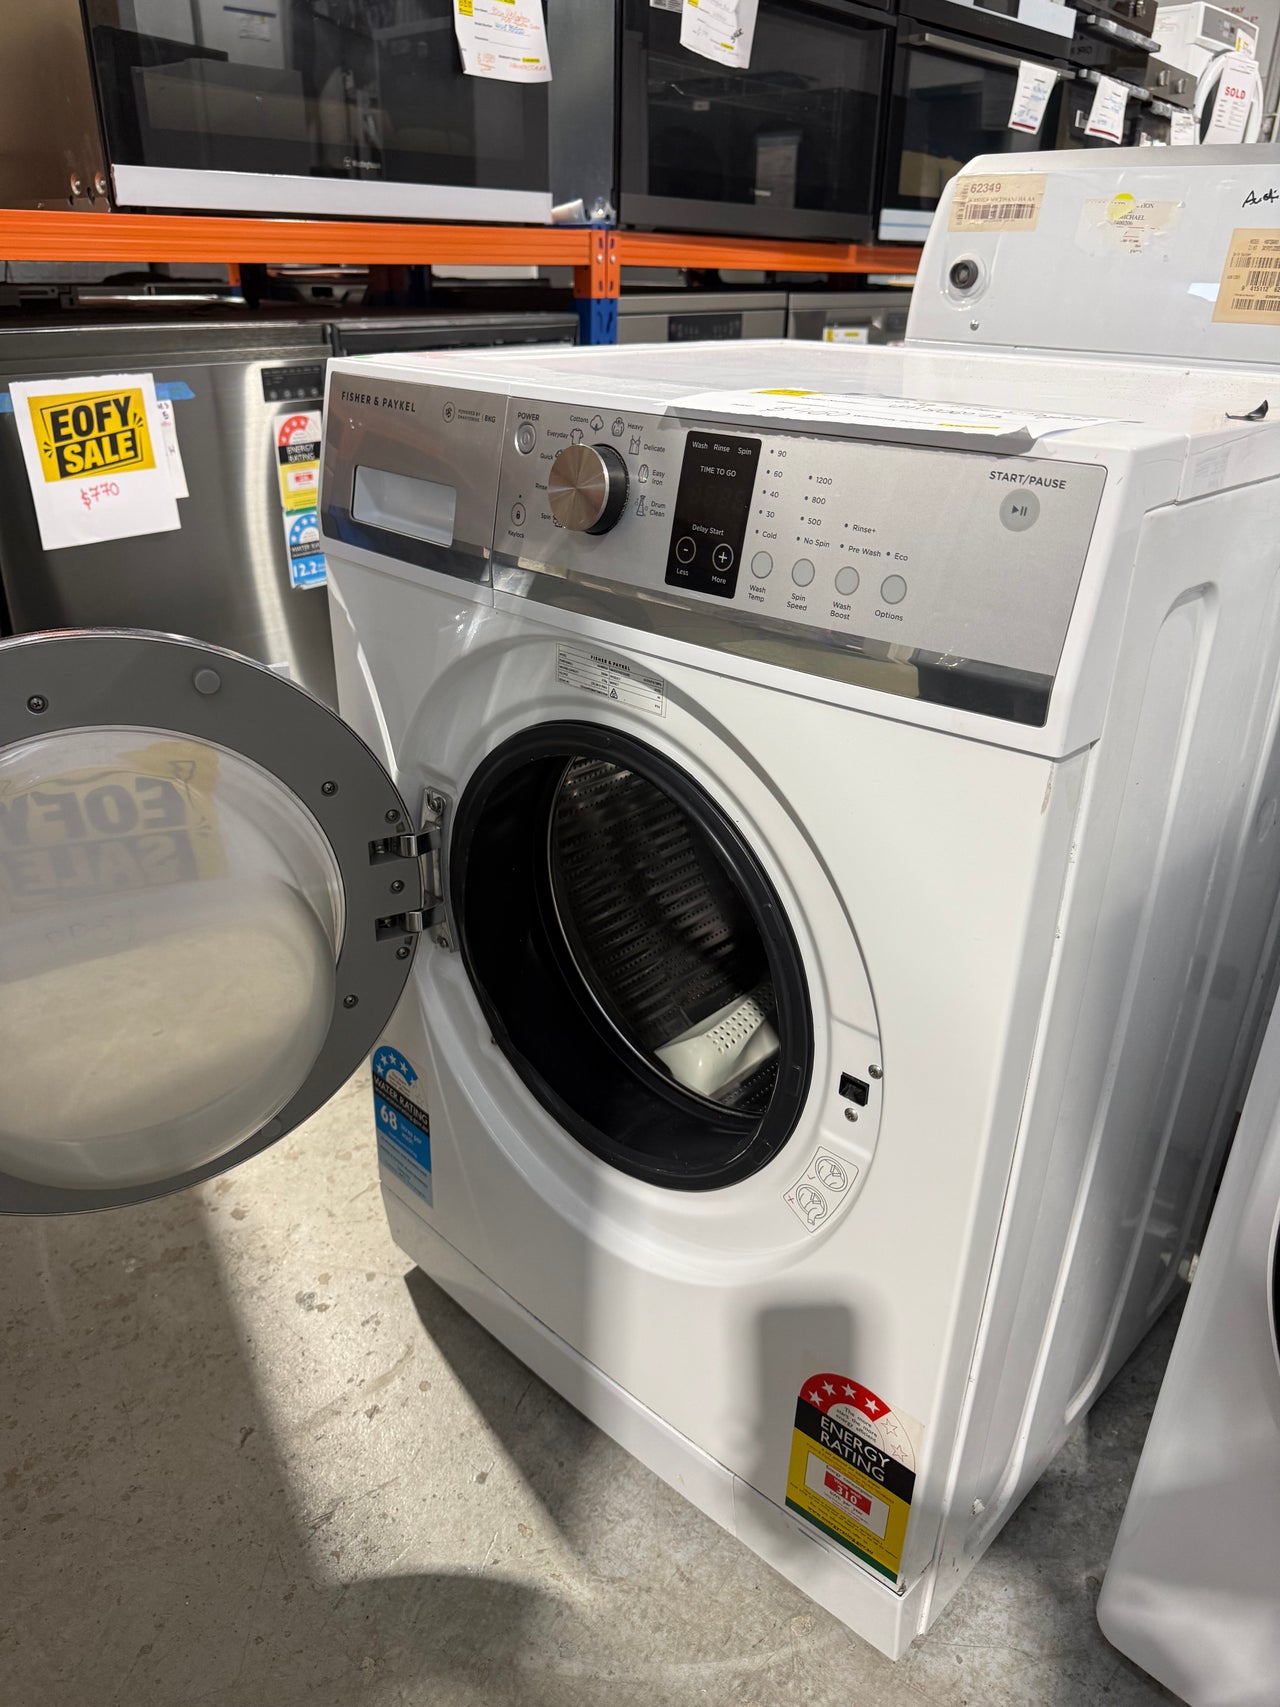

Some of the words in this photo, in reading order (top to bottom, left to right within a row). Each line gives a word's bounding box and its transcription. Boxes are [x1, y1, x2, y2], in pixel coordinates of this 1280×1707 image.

[1225, 86, 1246, 100] SOLD
[970, 183, 1001, 193] 62349
[341, 391, 371, 405] FISHER
[382, 398, 416, 413] PAYKEL
[50, 395, 131, 444] EOFY
[517, 412, 540, 421] POWER
[570, 415, 589, 424] Cottons
[627, 423, 644, 431] Heavy
[546, 430, 569, 440] Everyday
[63, 431, 135, 474] SALE
[287, 444, 315, 455] ENERGY
[643, 443, 666, 453] Delicate
[692, 441, 709, 450] Wash
[713, 443, 731, 452] Rinse
[737, 447, 752, 456] Spin
[540, 452, 554, 461] Quick
[777, 449, 787, 458] 90
[652, 469, 665, 479] Easy
[700, 465, 715, 475] TIME
[716, 468, 725, 476] TO
[726, 469, 737, 477] GO
[773, 470, 783, 478] 60
[652, 478, 663, 486] Iron
[816, 476, 833, 485] 1200
[989, 470, 1067, 490] START/PAUSE
[535, 482, 547, 491] Rinse
[80, 482, 120, 510] $770
[769, 490, 780, 499] 40
[650, 501, 666, 509] Drum
[811, 496, 826, 505] 800
[541, 513, 551, 521] Spin
[650, 509, 665, 517] Clean
[765, 510, 775, 519] 30
[807, 517, 822, 526] 500
[692, 524, 709, 535] Delay
[709, 527, 725, 536] Start
[852, 524, 876, 534] Rinse+
[508, 530, 525, 539] Keylock
[762, 530, 777, 540] Cold
[803, 537, 814, 545] No
[815, 539, 830, 548] Spin
[848, 545, 860, 553] Pre
[861, 548, 882, 557] Wash
[894, 552, 909, 561] Eco
[293, 561, 317, 578] 12.2
[676, 567, 689, 576] Less
[711, 575, 727, 585] More
[749, 584, 767, 594] Wash
[748, 593, 765, 602] Temp
[791, 593, 806, 601] Spin
[786, 601, 808, 611] Speed
[832, 601, 852, 610] Wash
[830, 610, 850, 620] Boost
[874, 610, 903, 621] Options
[374, 1074, 399, 1101] WATER
[399, 1095, 429, 1126] RATING
[380, 1104, 398, 1131] 68
[835, 1413, 854, 1428] energy
[845, 1406, 855, 1417] The
[857, 1416, 872, 1428] more
[851, 1418, 861, 1427] the
[862, 1425, 878, 1438] more
[820, 1416, 890, 1468] ENERGY
[821, 1432, 885, 1482] RATING
[837, 1485, 858, 1505] 310
